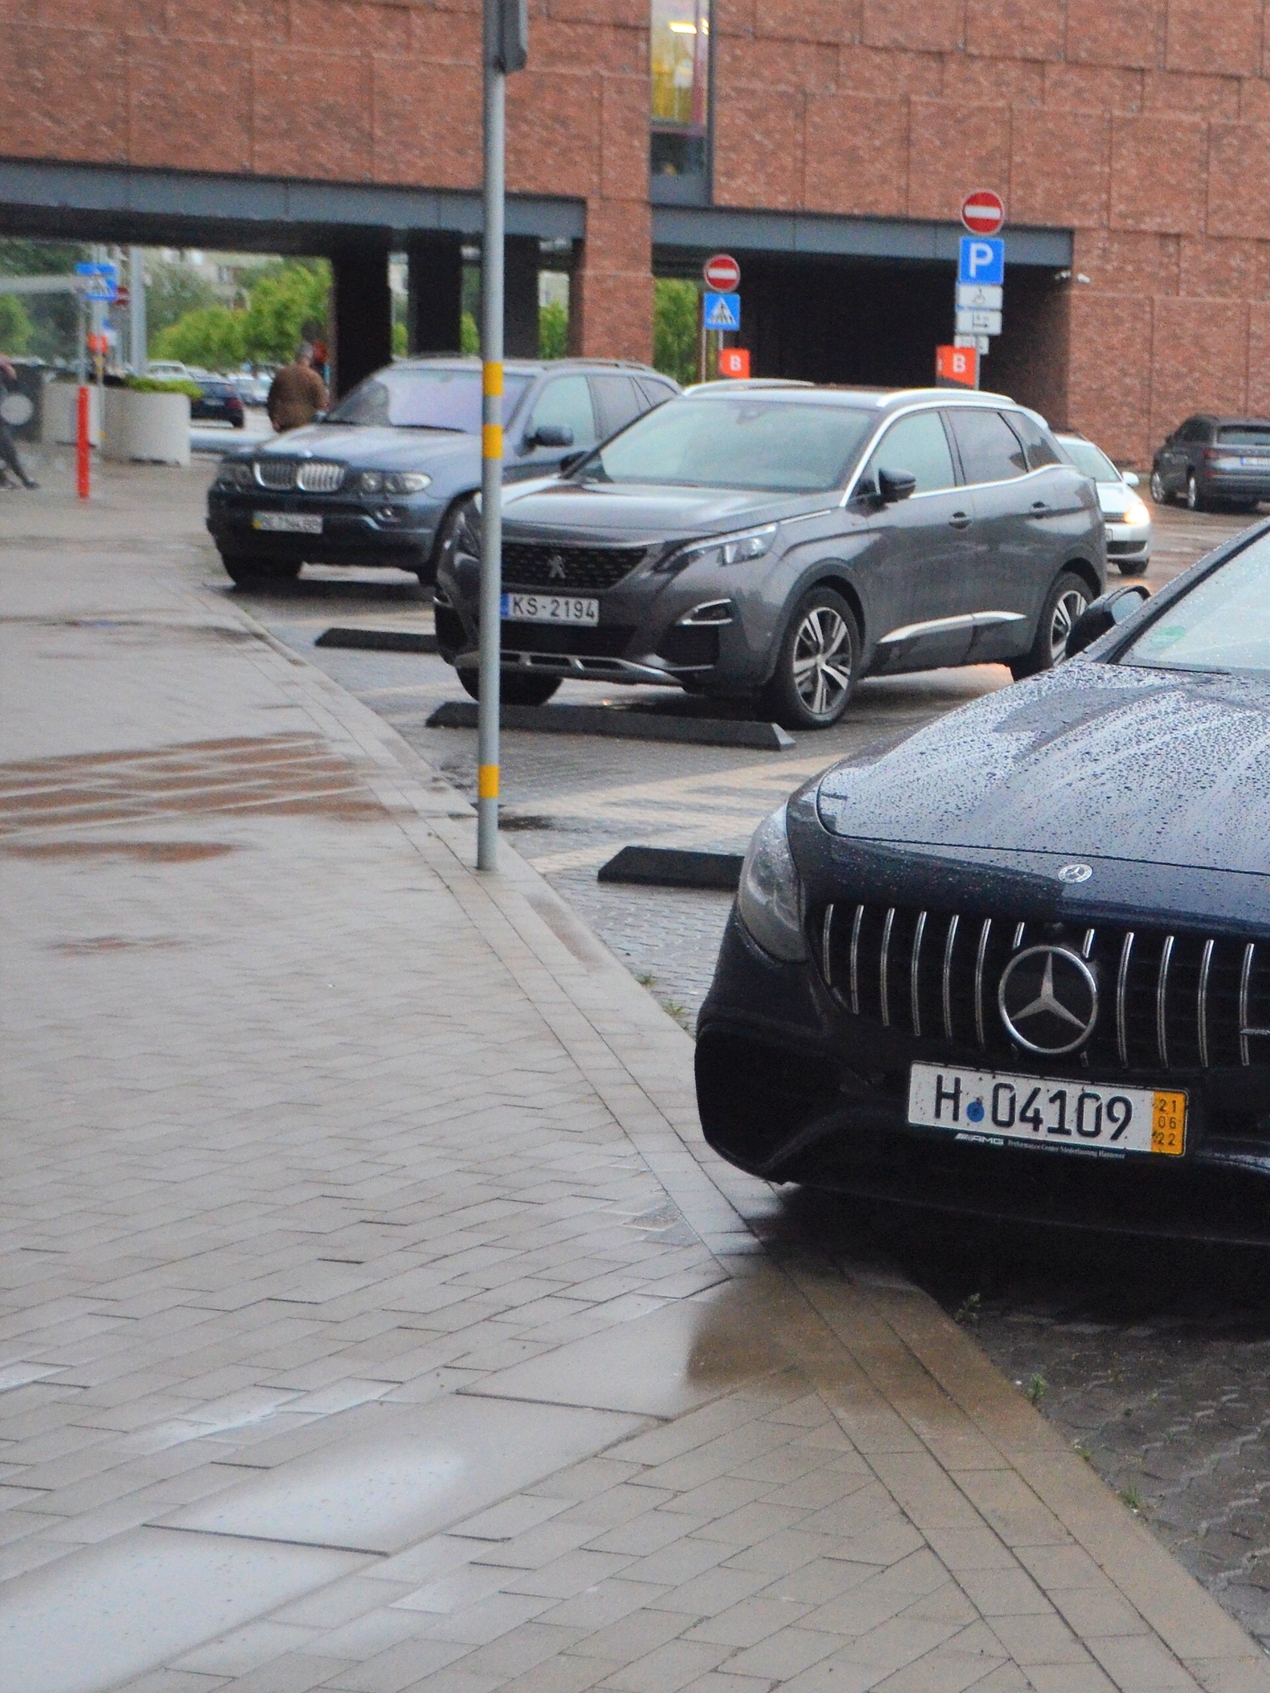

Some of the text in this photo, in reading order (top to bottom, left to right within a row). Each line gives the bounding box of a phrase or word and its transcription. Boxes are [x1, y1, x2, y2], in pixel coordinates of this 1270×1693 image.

[969, 242, 994, 279] P
[730, 355, 742, 371] B
[952, 353, 966, 373] B
[935, 1074, 1133, 1141] H 04109
[1159, 1098, 1177, 1113] 21
[1158, 1115, 1177, 1130] 06
[1157, 1132, 1176, 1146] 22
